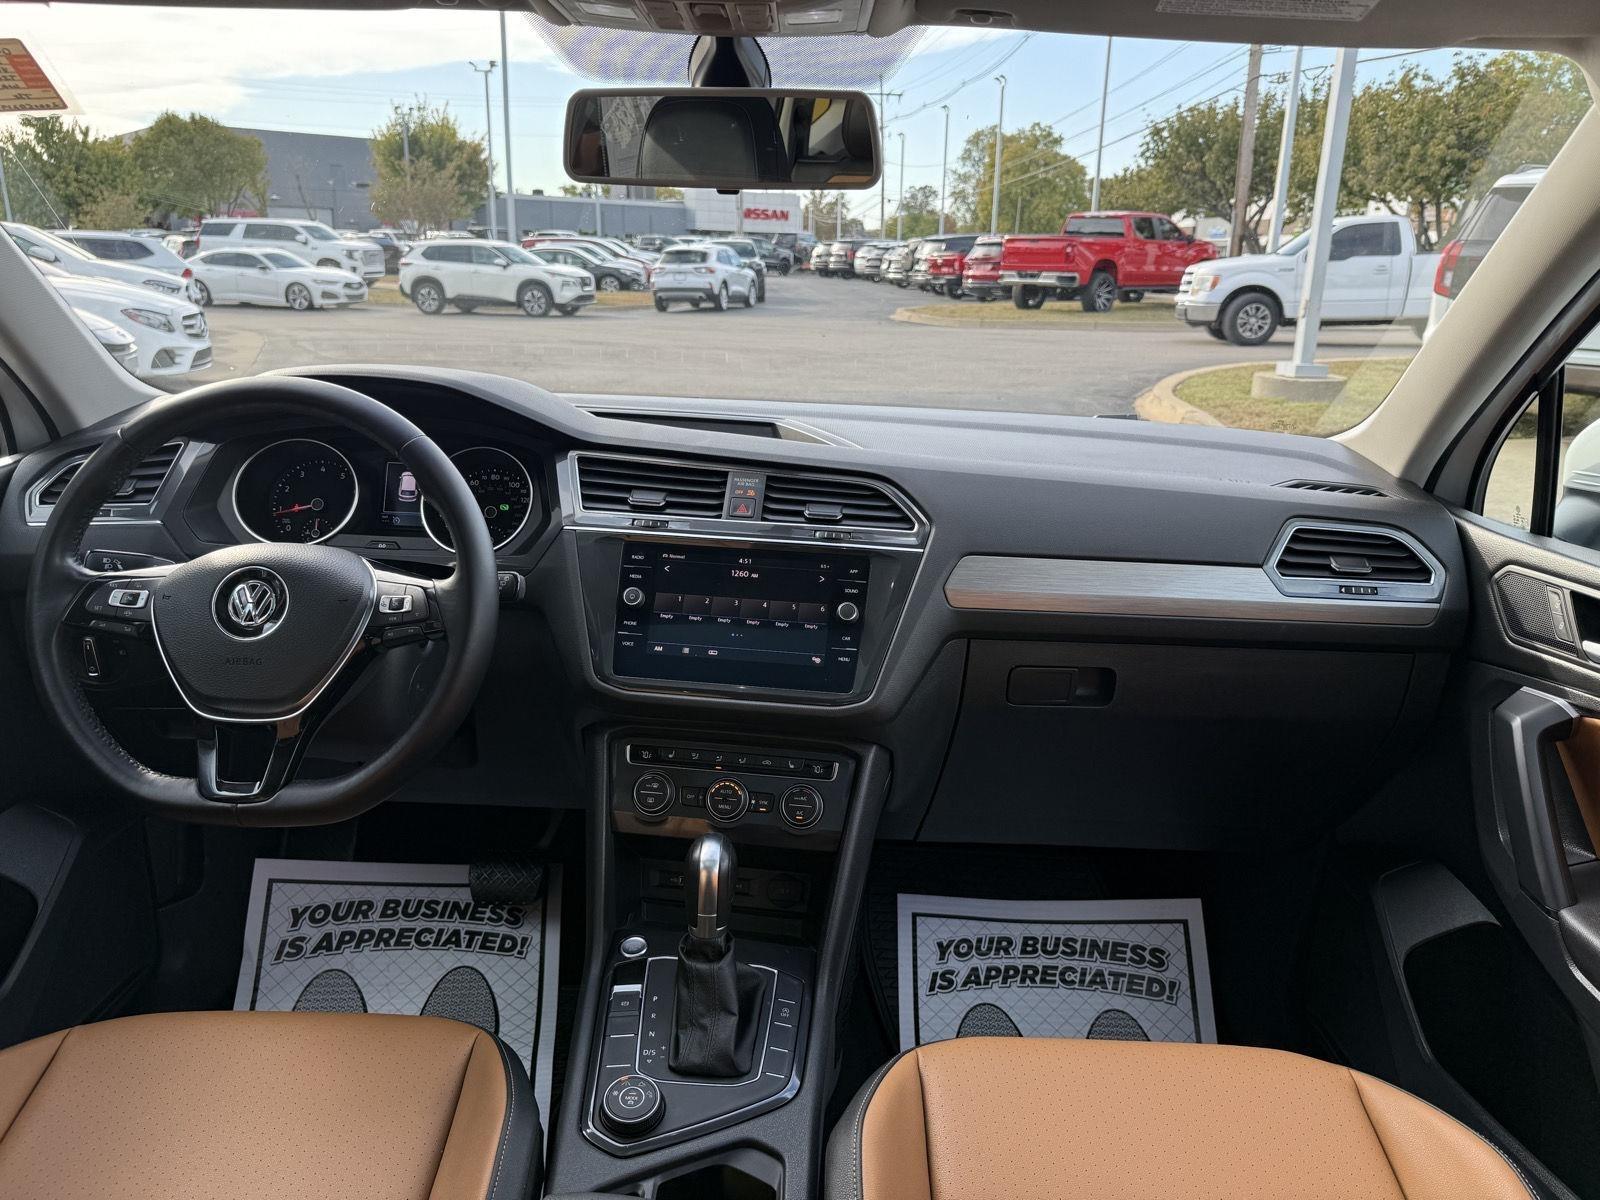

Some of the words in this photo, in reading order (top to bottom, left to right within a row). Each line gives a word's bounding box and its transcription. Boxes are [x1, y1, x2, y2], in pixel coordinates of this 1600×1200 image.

[508, 481, 520, 489] 100
[731, 569, 749, 578] 1260
[225, 657, 263, 666] AIRBAG
[289, 899, 374, 929] YOUR
[379, 899, 527, 928] BUSINESS
[273, 934, 309, 962] IS
[311, 928, 531, 958] APPRECIATED!
[936, 936, 1016, 962] YOUR
[1019, 935, 1171, 971] BUSINESS
[928, 970, 960, 994] IS
[962, 965, 1182, 1004] APPRECIATED!
